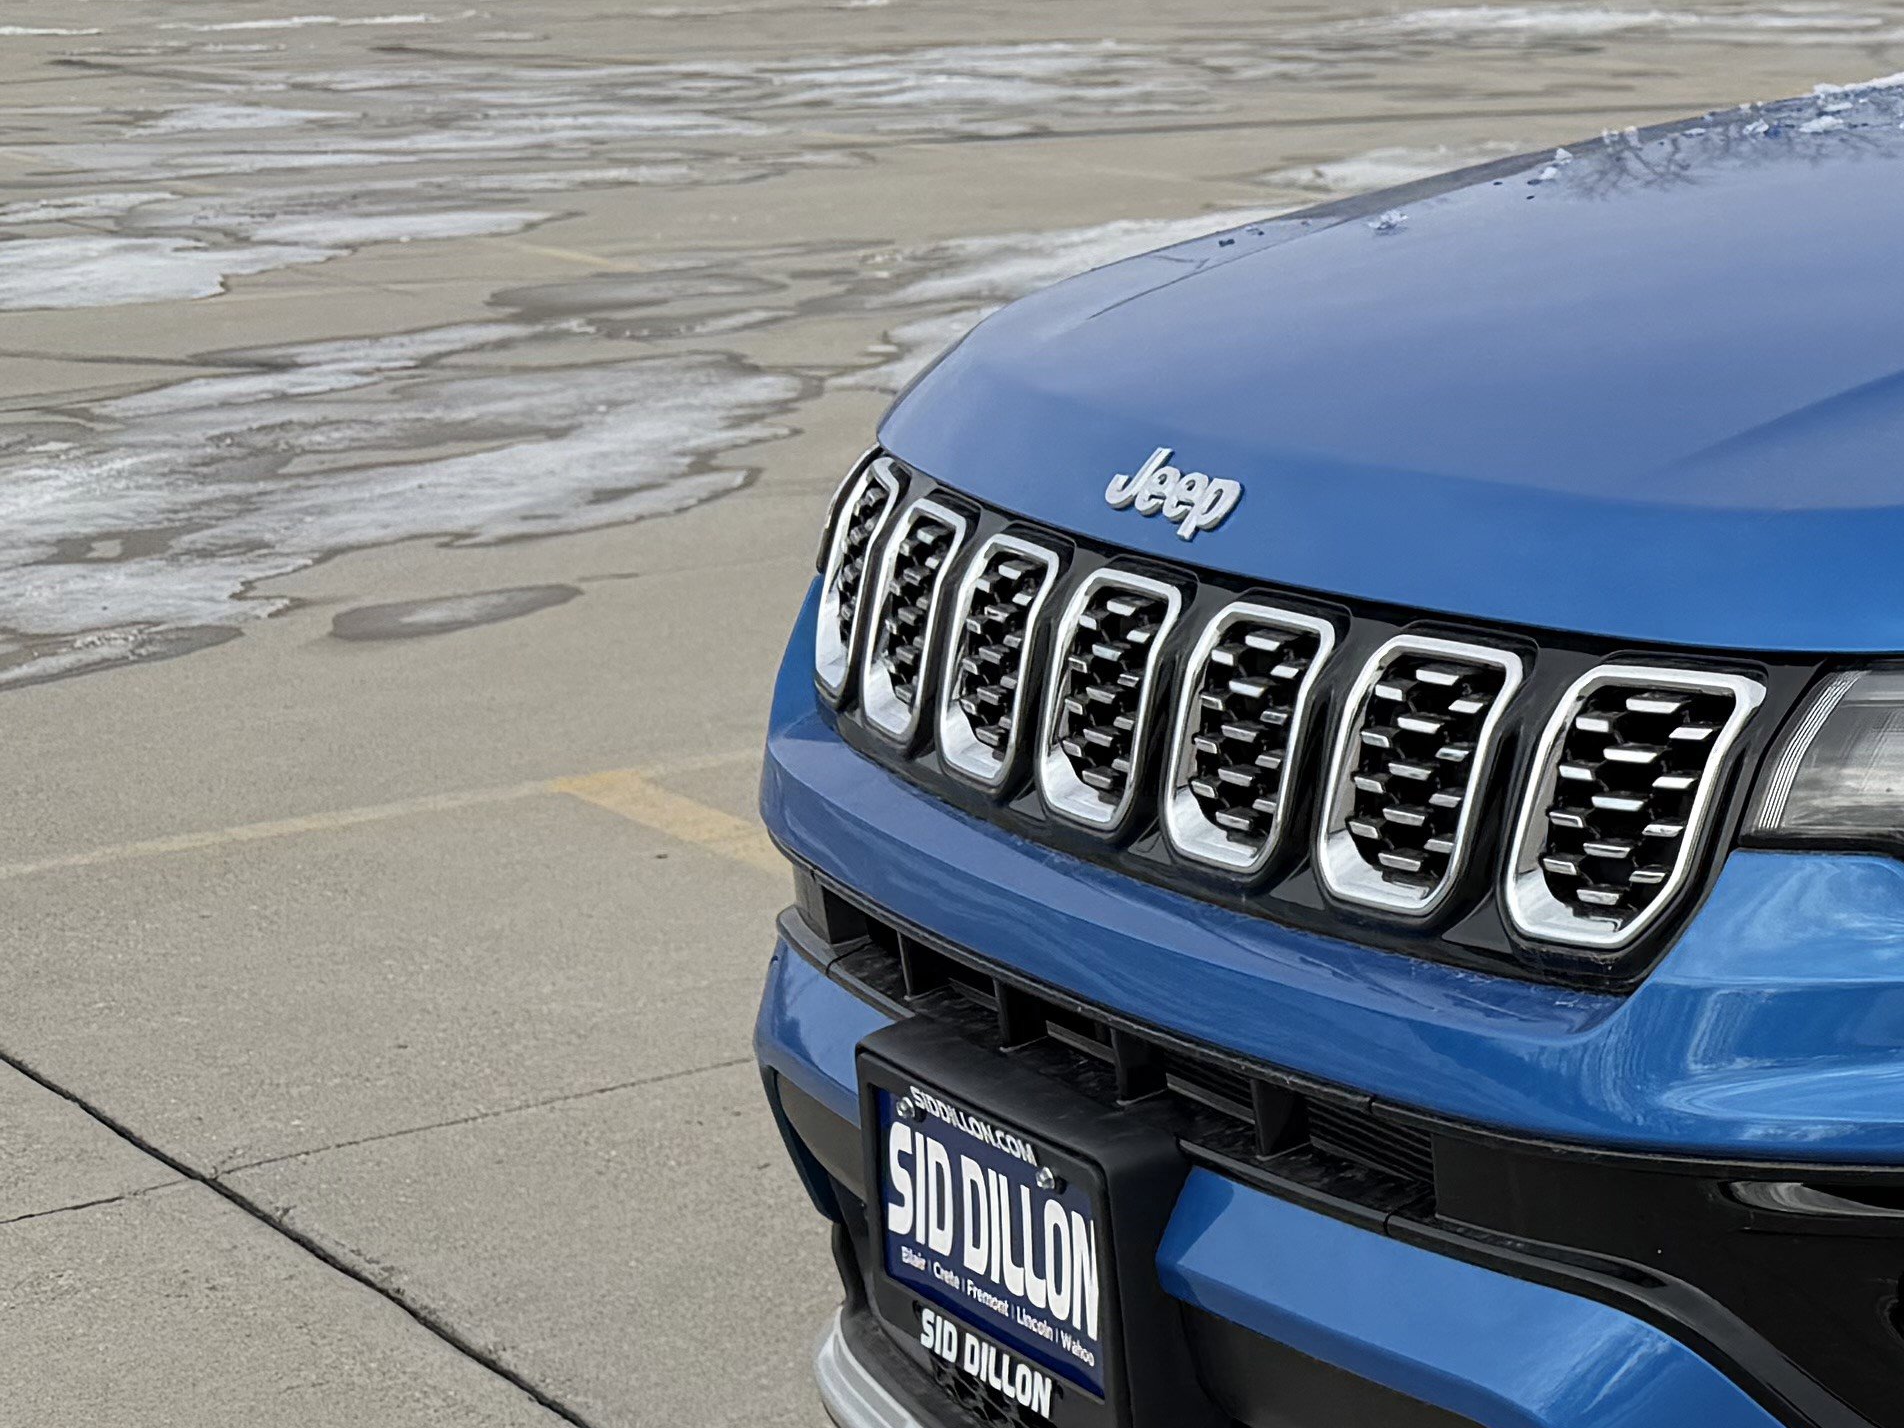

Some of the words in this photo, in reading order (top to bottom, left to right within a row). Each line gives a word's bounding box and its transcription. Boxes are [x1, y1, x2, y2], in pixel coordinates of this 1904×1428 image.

[1105, 446, 1242, 540] Jeep
[910, 1085, 1037, 1167] SIDDILLON.COM
[888, 1121, 954, 1256] SID
[961, 1154, 1099, 1341] DILLON
[920, 1308, 958, 1364] SID
[963, 1331, 1053, 1420] DILLON
[966, 1279, 1009, 1317] Fremont
[1016, 1305, 1054, 1342] Lincoln
[1059, 1329, 1096, 1367] Wahoo
